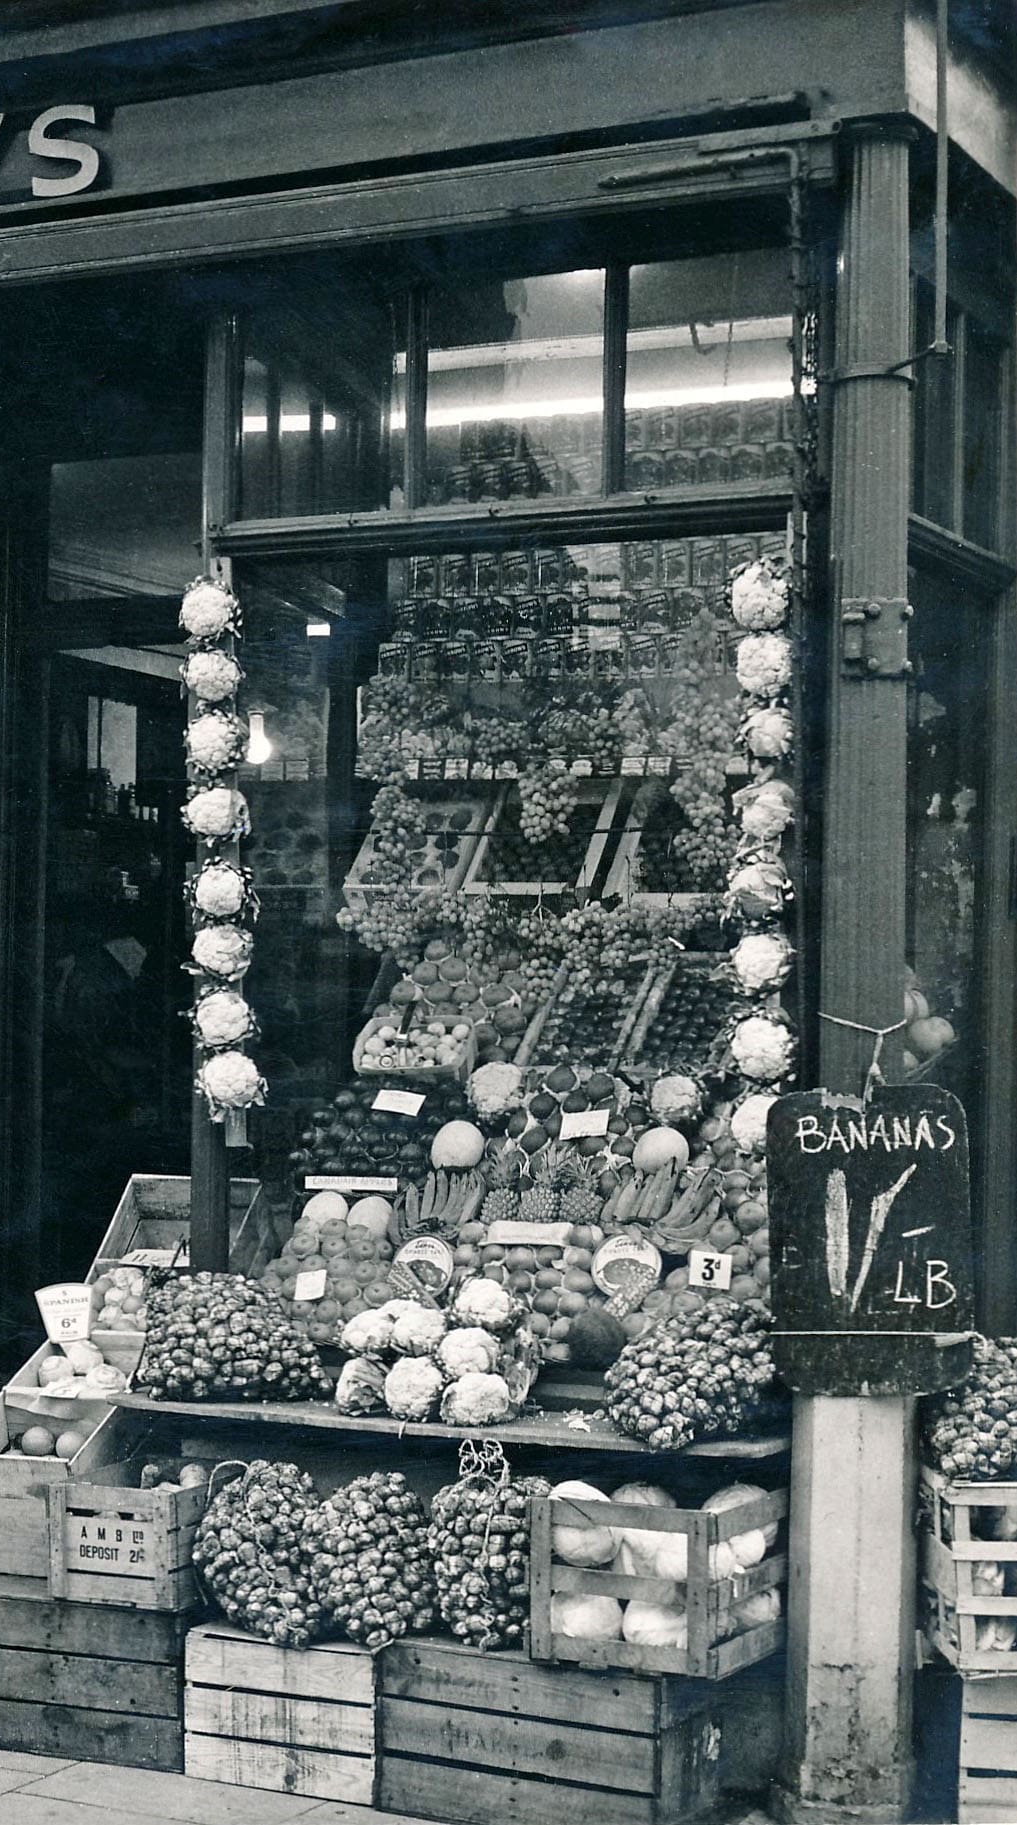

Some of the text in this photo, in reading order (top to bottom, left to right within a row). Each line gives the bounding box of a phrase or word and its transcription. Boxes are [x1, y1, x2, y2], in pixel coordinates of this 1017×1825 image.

[795, 1113, 955, 1153] BANANAS
[701, 1257, 721, 1281] 3d
[894, 1259, 957, 1309] LB
[61, 1318, 77, 1329] 6d
[80, 1525, 88, 1539] A
[97, 1527, 106, 1541] M
[115, 1529, 123, 1542] B
[79, 1544, 120, 1561] DEPOSIT
